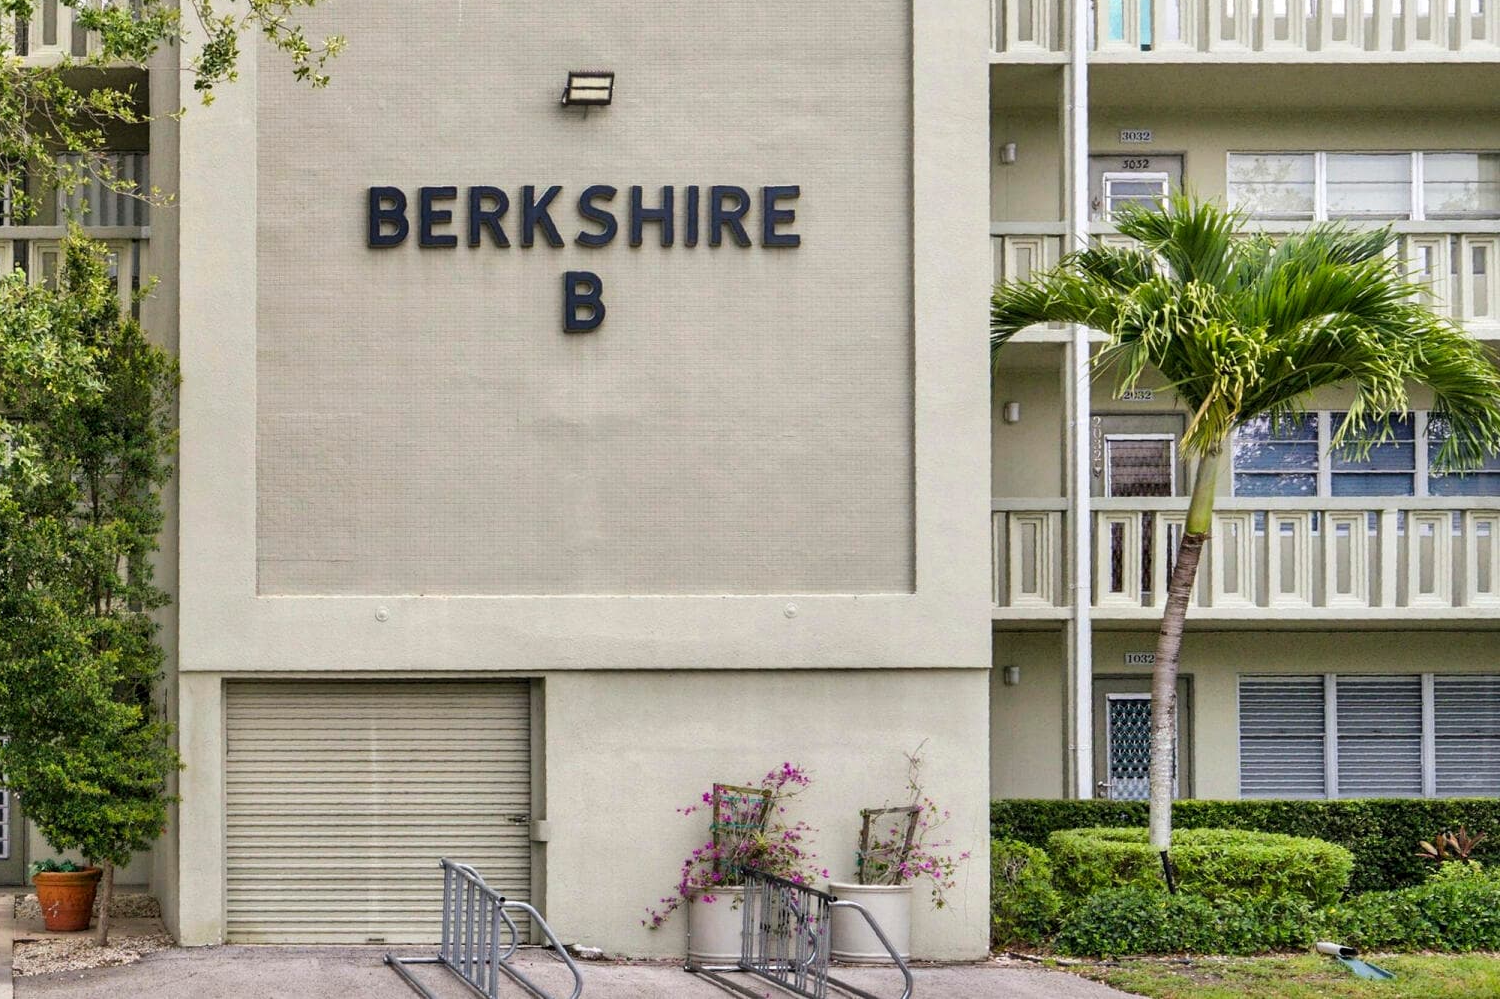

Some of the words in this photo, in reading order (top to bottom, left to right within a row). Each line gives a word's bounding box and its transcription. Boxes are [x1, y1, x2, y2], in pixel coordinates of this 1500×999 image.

[1122, 131, 1150, 141] 3032
[1122, 158, 1150, 169] 3032
[367, 185, 801, 247] BERKSHIRE
[562, 271, 606, 333] B
[1128, 654, 1155, 664] 1032
